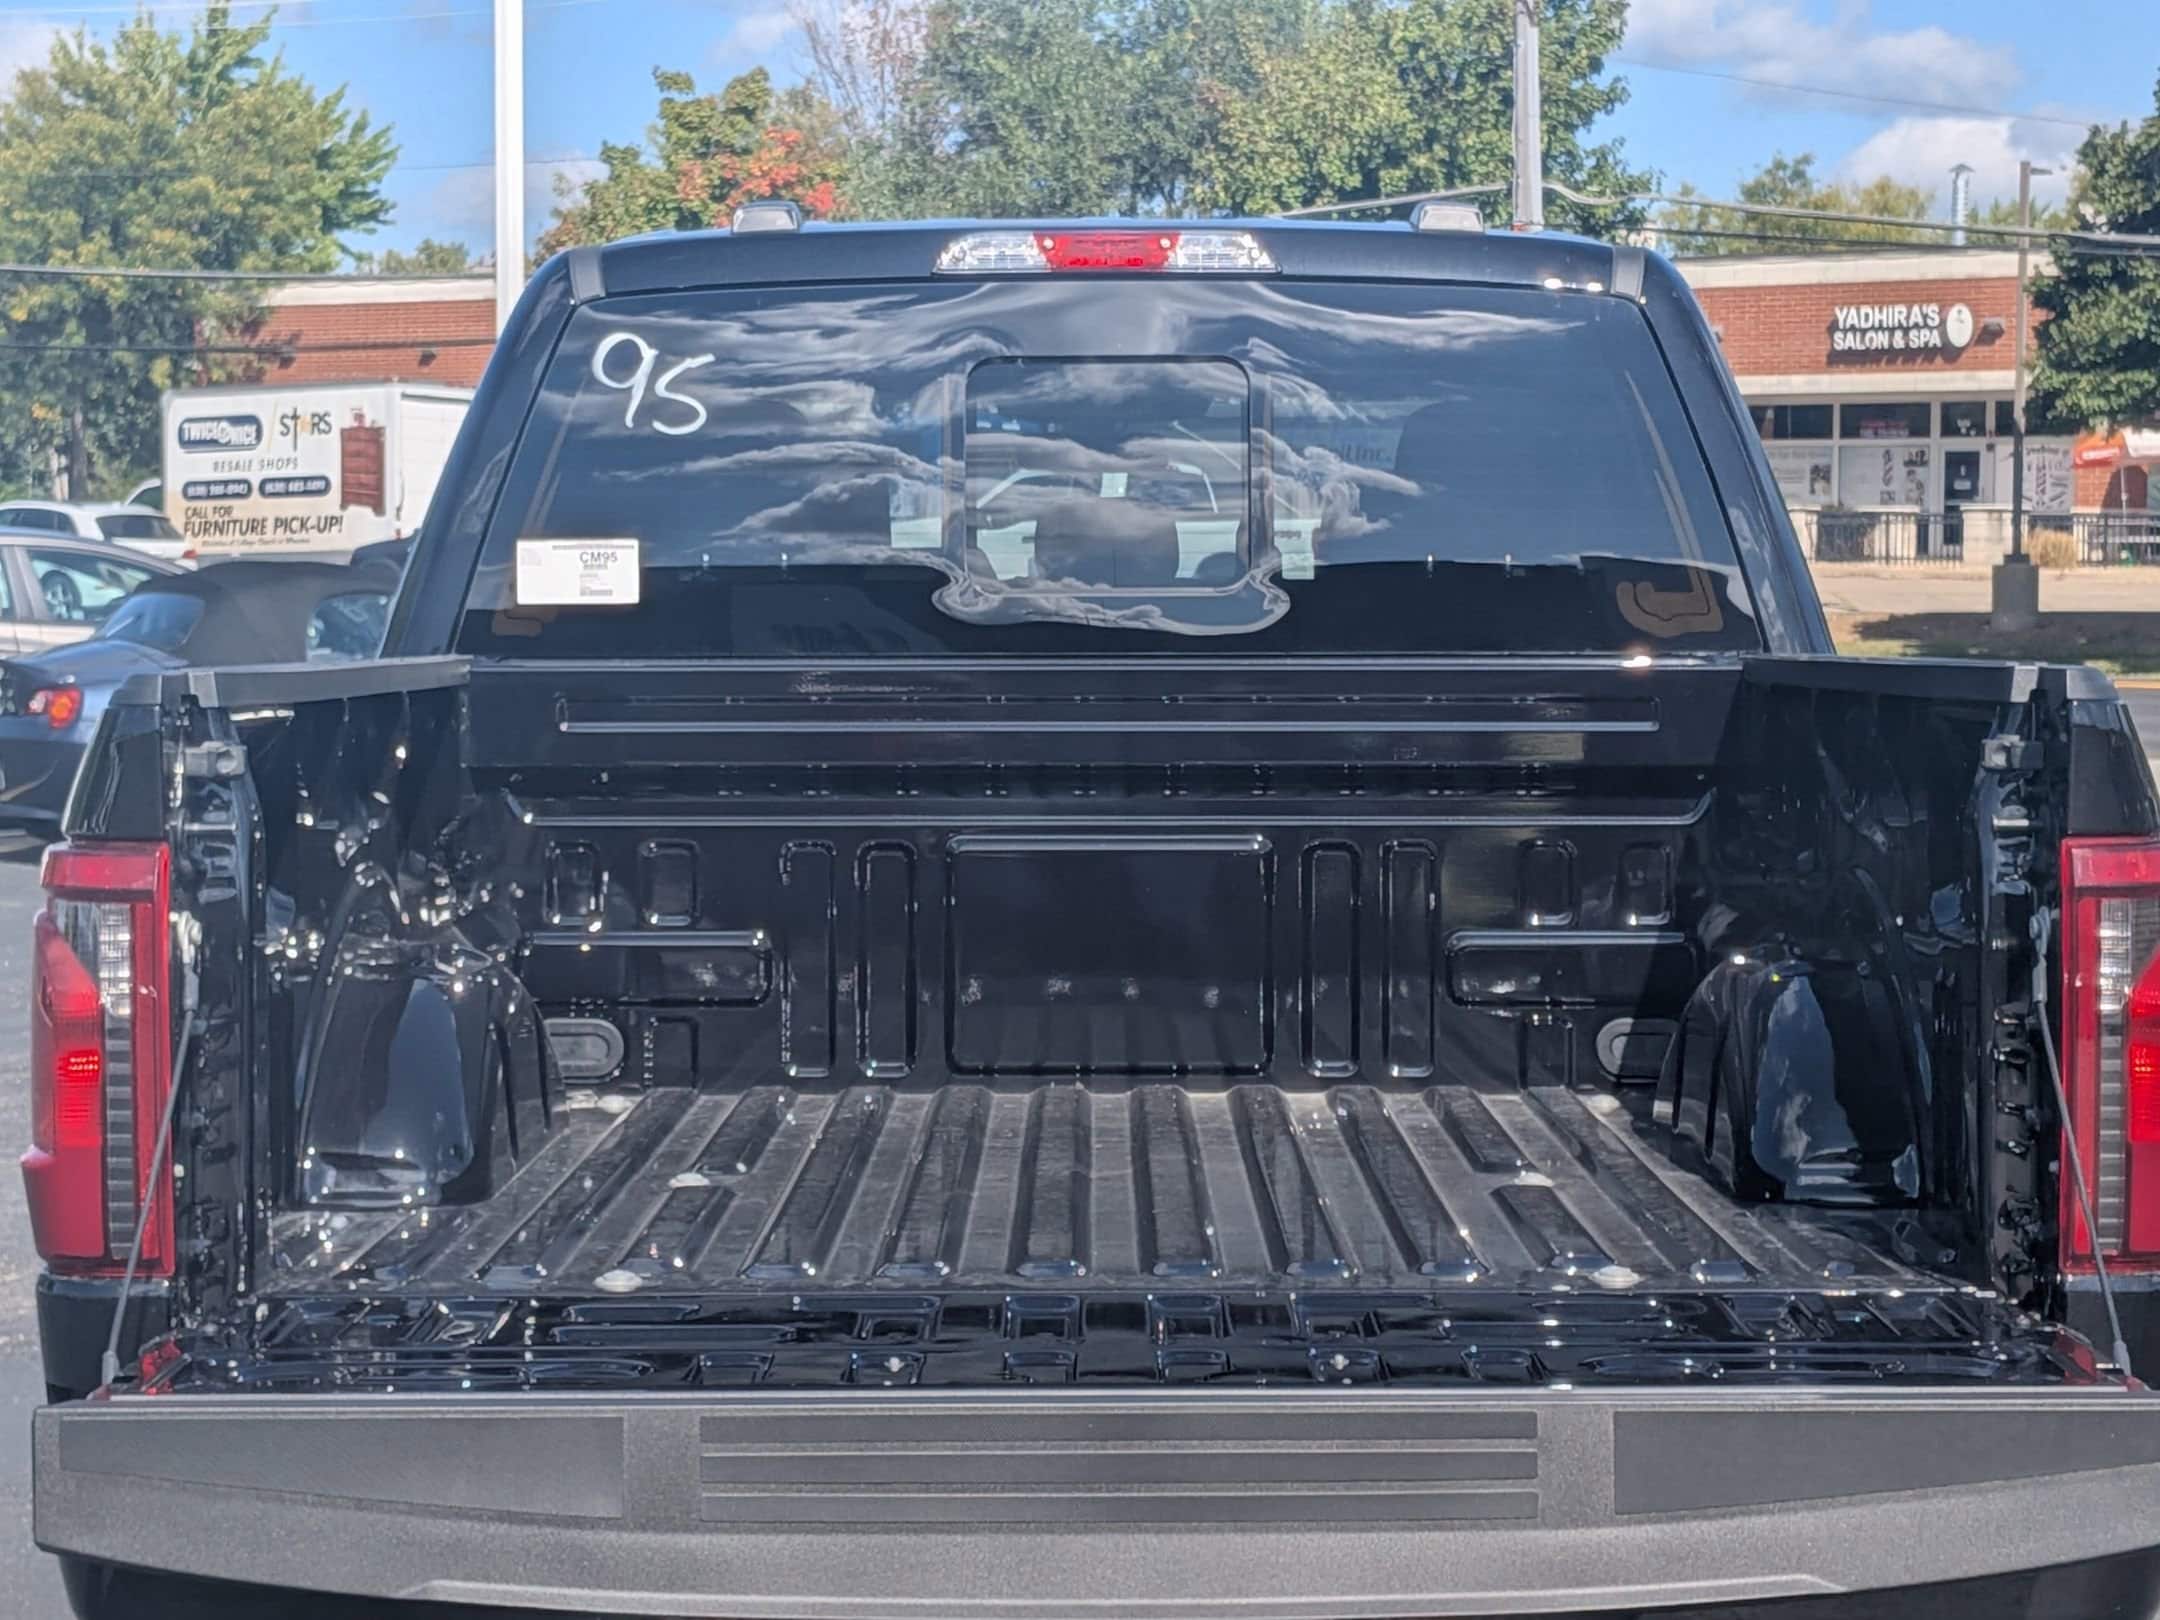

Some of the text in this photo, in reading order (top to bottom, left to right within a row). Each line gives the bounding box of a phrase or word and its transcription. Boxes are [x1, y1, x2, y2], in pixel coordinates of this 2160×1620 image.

[1834, 304, 1940, 329] YADHIRA'S
[1833, 329, 1942, 350] SALON & SPA
[592, 332, 716, 435] 95
[213, 457, 298, 473] RESALE SHOPS
[184, 504, 234, 519] CALL FOR
[184, 515, 344, 538] FURNITURE PICK-UP!
[579, 551, 618, 564] CM95
